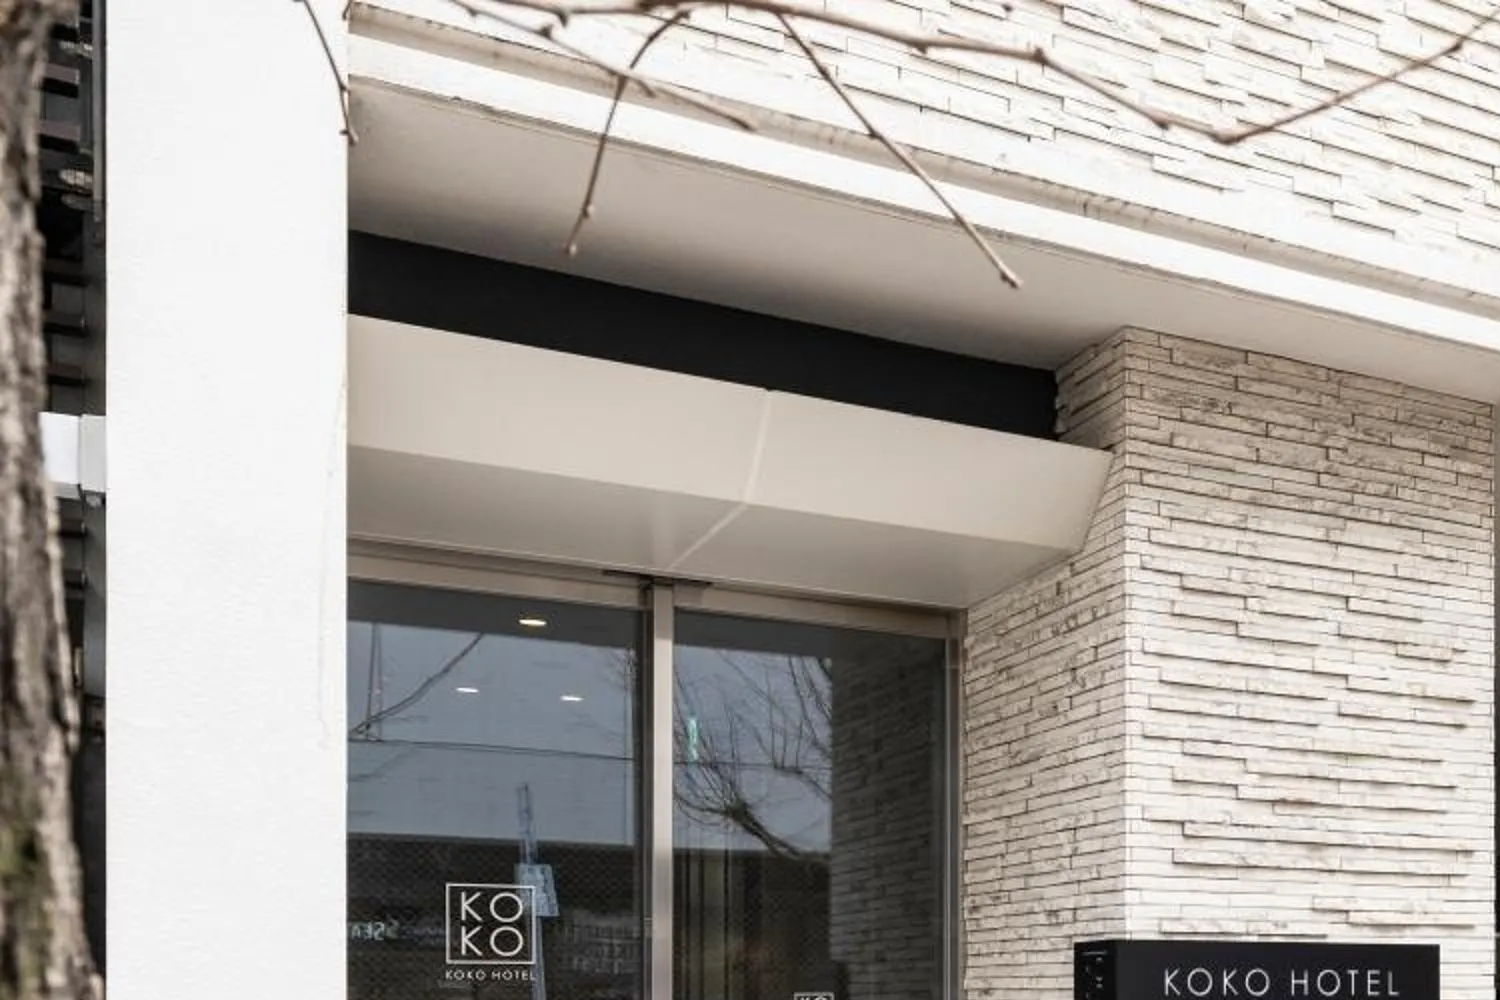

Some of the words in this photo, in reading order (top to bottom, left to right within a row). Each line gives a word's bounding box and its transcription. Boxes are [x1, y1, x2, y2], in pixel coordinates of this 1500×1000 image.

[445, 969, 486, 981] KOKO
[491, 969, 536, 981] HOTEL
[1163, 967, 1271, 997] KOKO
[1290, 968, 1401, 997] HOTEL
